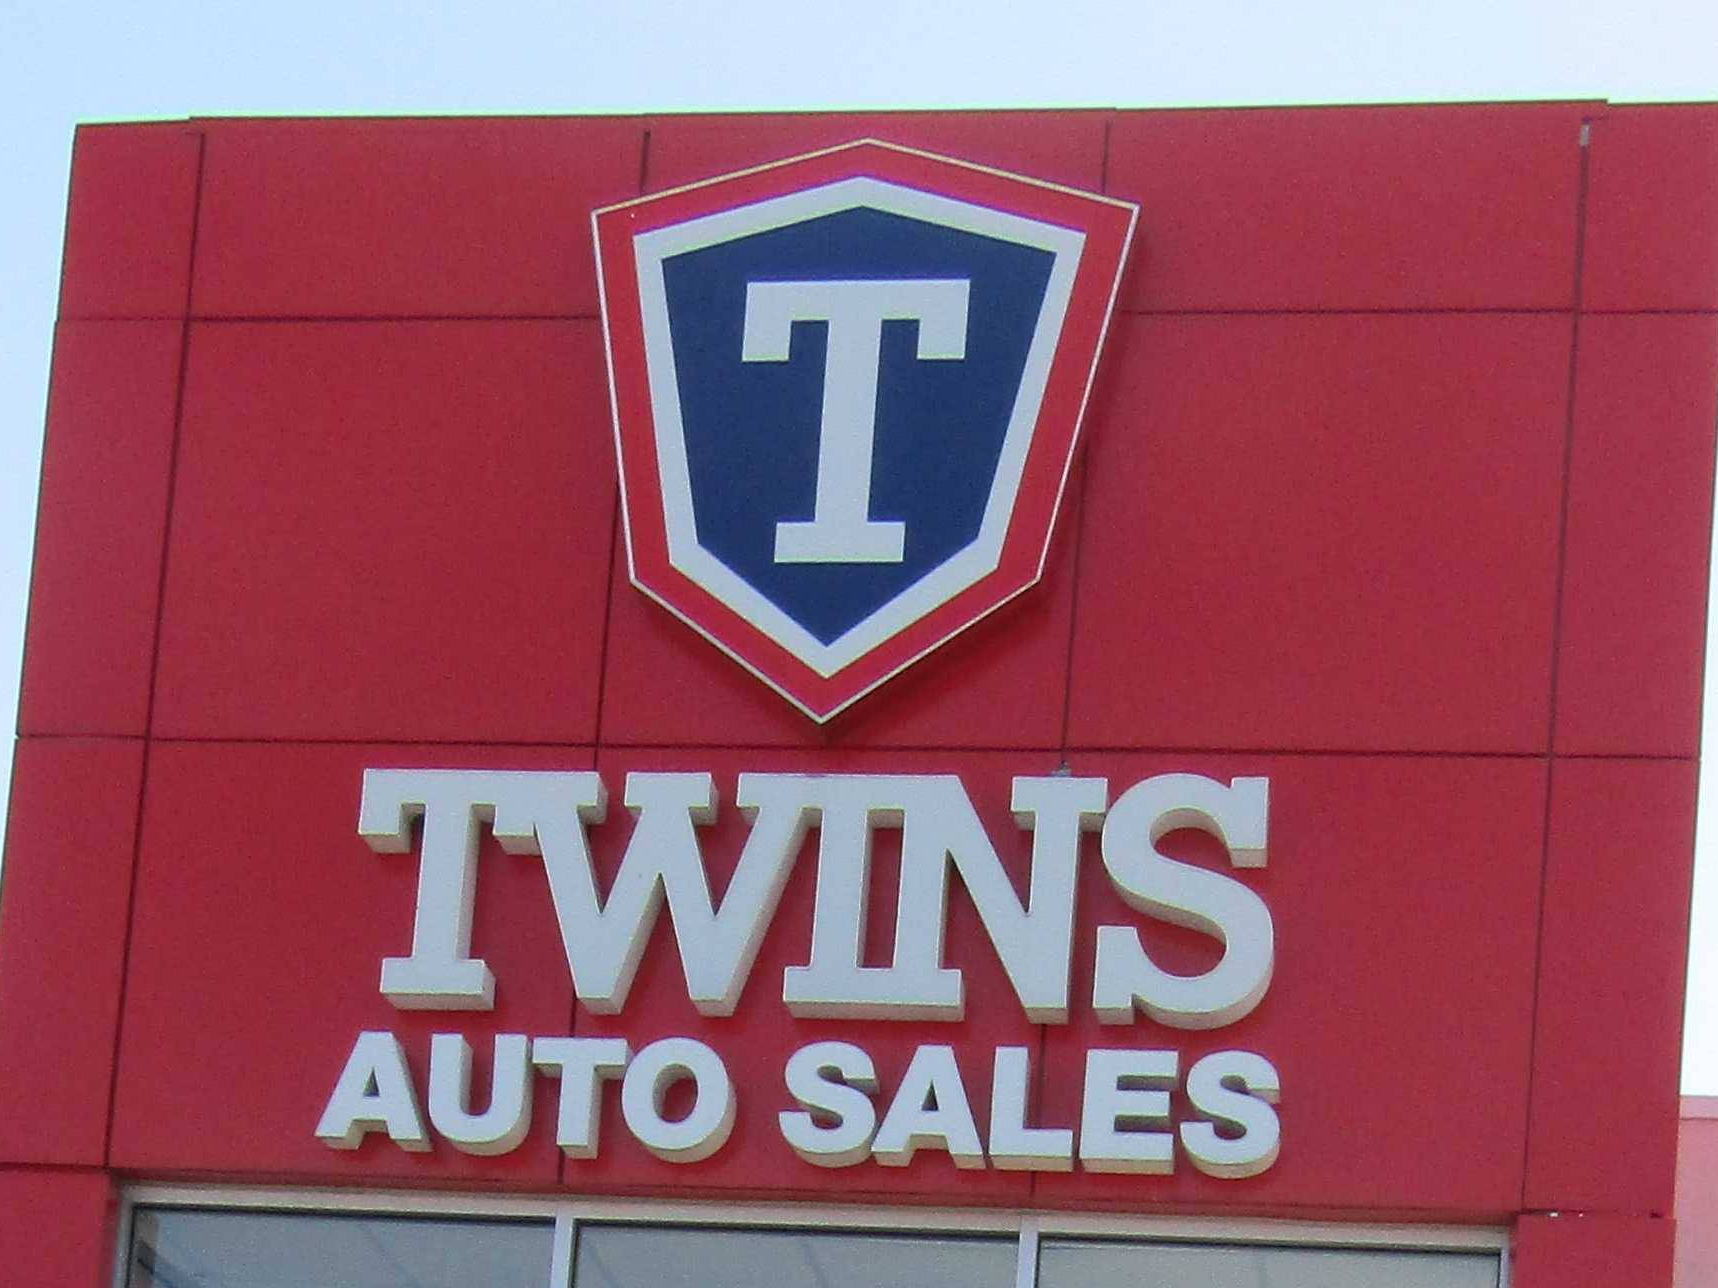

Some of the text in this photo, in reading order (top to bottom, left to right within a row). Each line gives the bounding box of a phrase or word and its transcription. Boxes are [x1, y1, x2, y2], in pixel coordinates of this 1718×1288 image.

[742, 279, 970, 562] T
[356, 767, 1275, 1031] TWINS
[314, 1029, 1283, 1178] AUTO SALES
